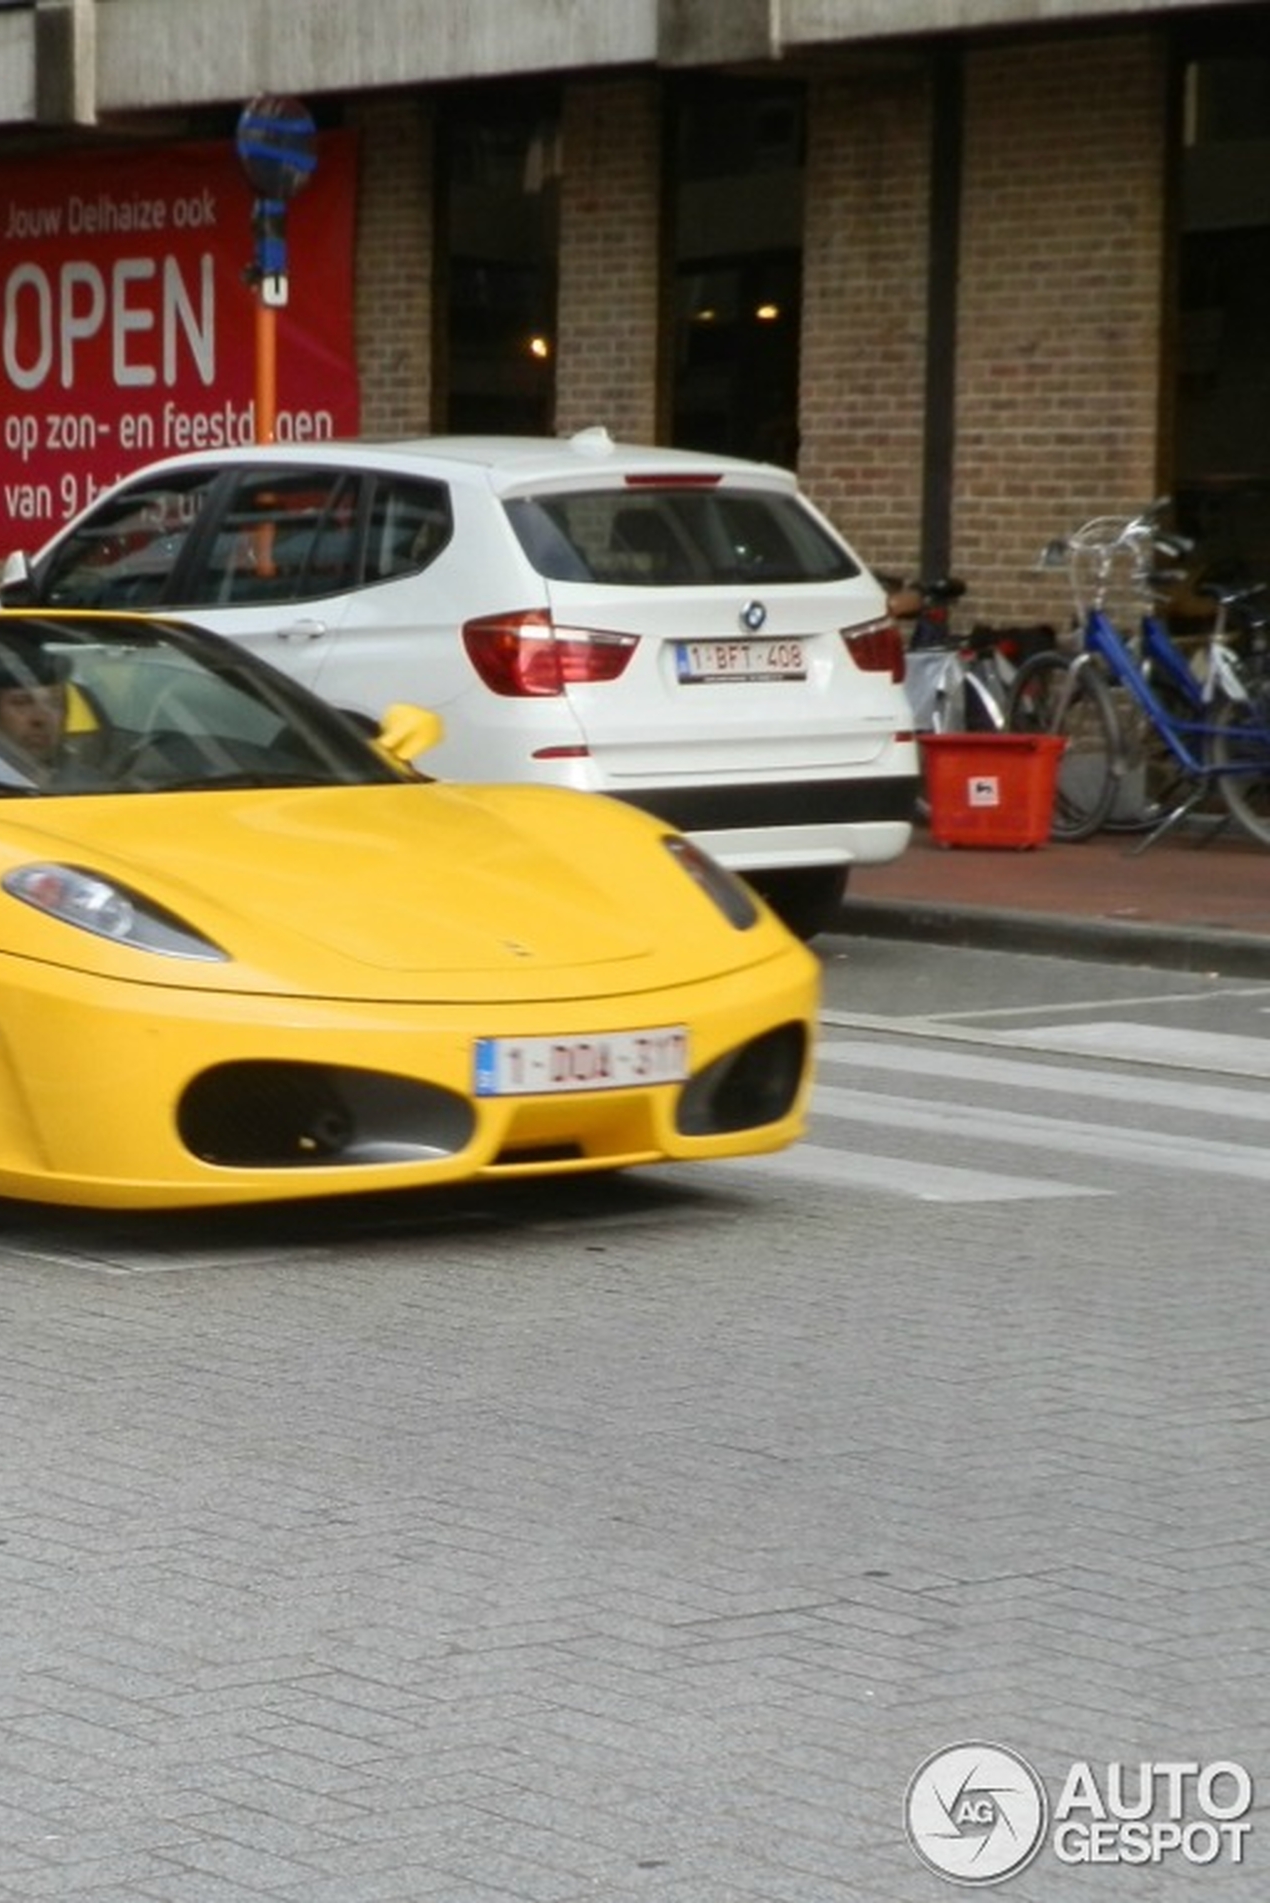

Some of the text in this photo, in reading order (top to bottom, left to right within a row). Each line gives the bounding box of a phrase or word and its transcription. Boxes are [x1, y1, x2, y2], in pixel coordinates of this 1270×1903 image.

[5, 188, 217, 239] Jouw Delhaize ook
[3, 253, 215, 390] OPEN
[5, 400, 333, 461] op zon- en feestdgen
[4, 484, 52, 518] van
[60, 475, 78, 520] 9
